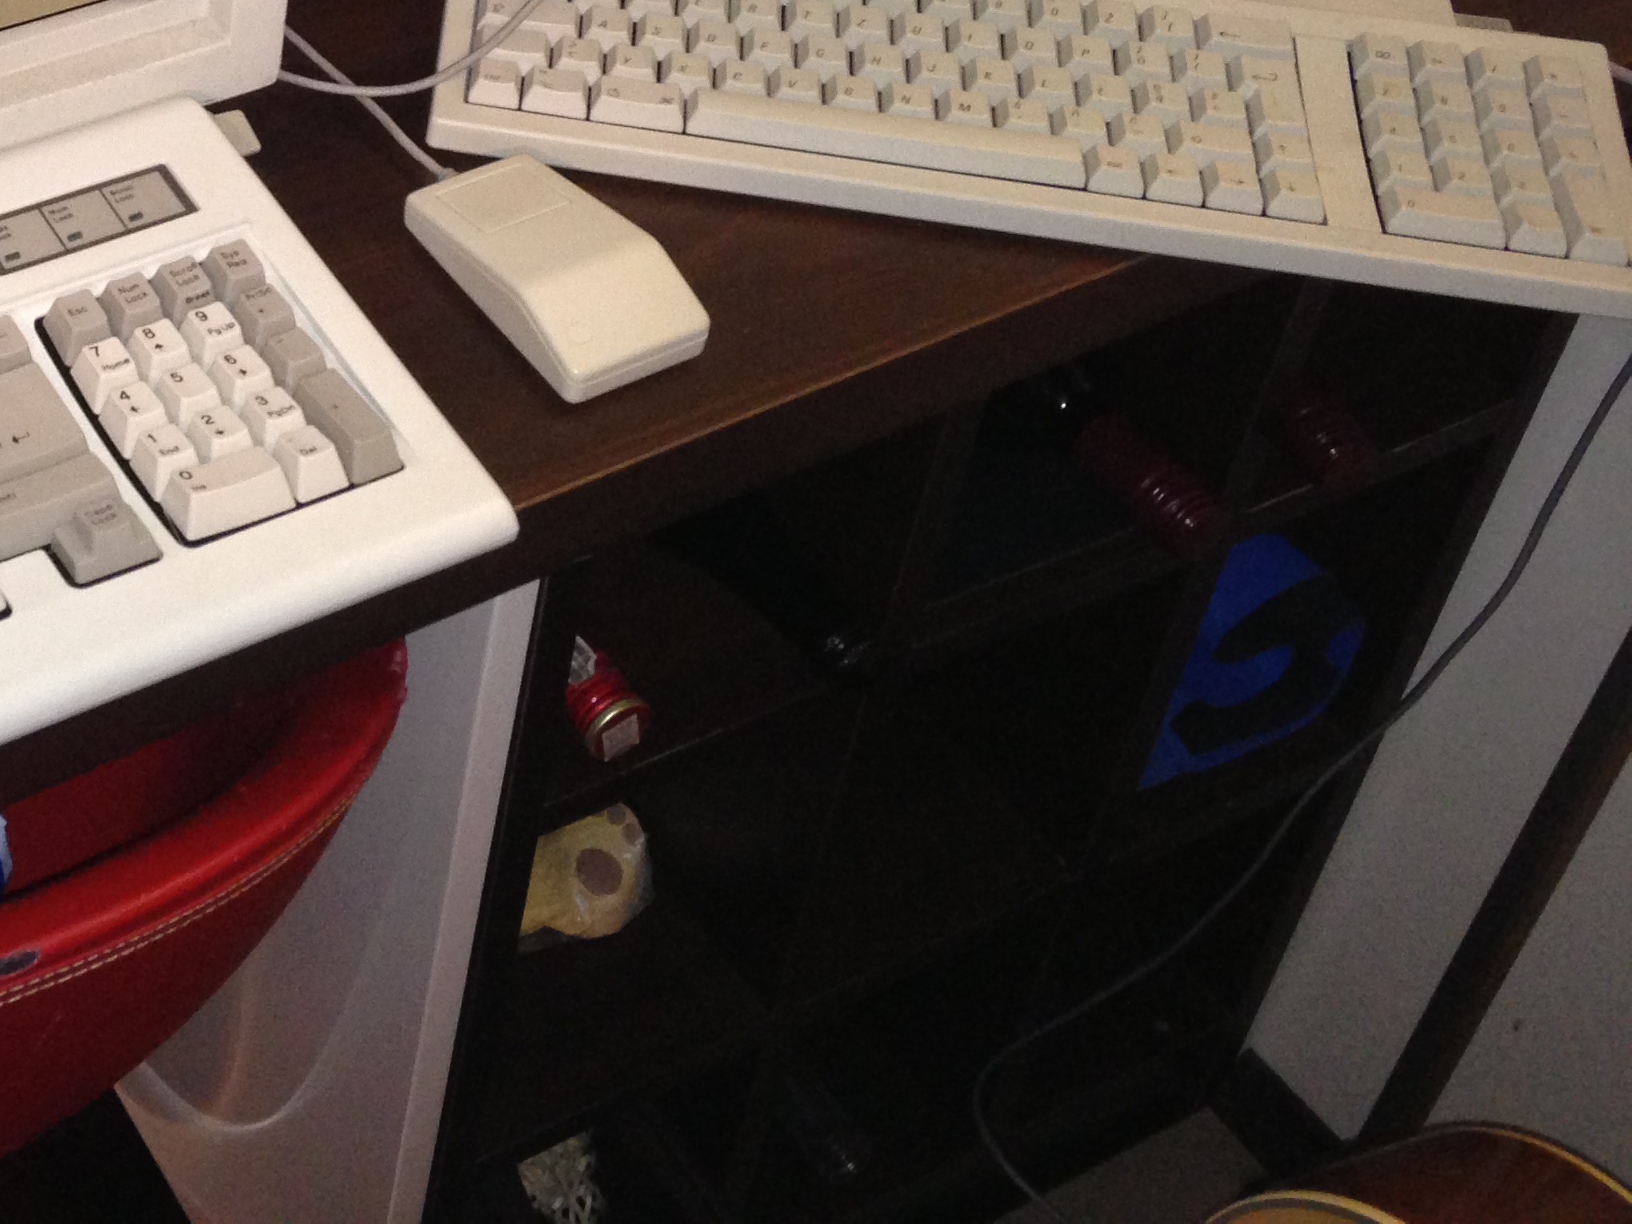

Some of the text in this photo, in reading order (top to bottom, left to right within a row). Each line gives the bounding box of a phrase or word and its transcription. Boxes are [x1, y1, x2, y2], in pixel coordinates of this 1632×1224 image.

[732, 72, 742, 80] C
[900, 95, 912, 104] N
[958, 103, 972, 112] M
[169, 262, 198, 278] Scroll
[175, 275, 200, 286] Lock
[118, 283, 140, 294] Num
[123, 292, 148, 304] Lock
[67, 307, 88, 317] Esc
[195, 312, 208, 322] 9
[142, 329, 156, 339] 8
[89, 347, 100, 357] 7
[101, 358, 131, 371] Home
[224, 354, 237, 365] 6
[169, 372, 184, 383] 5
[119, 390, 131, 401] 4
[255, 396, 267, 405] 3
[201, 415, 215, 426] 2
[147, 434, 157, 443] 1
[159, 445, 180, 455] End
[179, 471, 192, 481] 0
